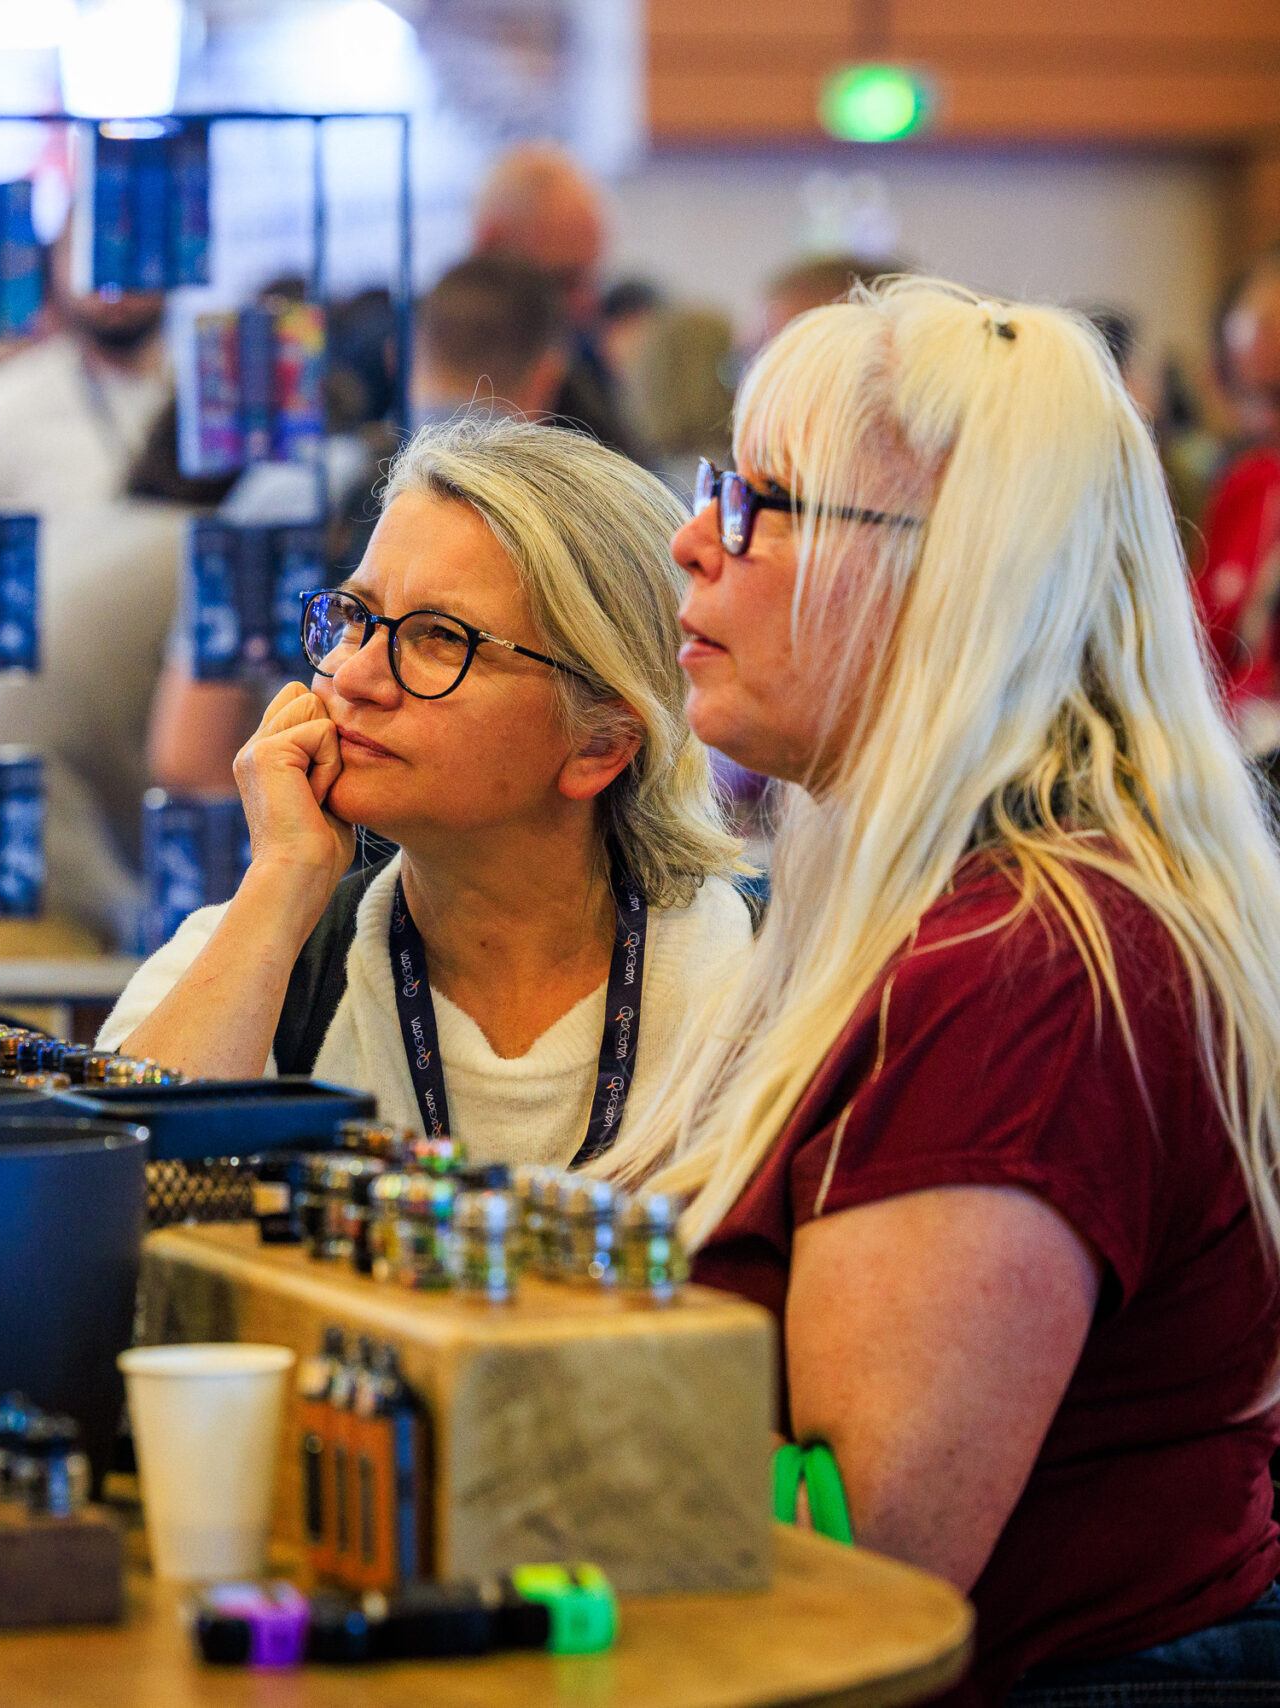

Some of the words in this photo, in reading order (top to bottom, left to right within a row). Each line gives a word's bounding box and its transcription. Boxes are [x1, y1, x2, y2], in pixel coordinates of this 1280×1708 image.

[400, 949, 419, 998] VAPEXPO
[623, 932, 640, 985] VAPEXPO
[410, 1016, 430, 1070] VAPEXPO
[616, 1005, 633, 1059] VAPEXPO
[603, 1076, 624, 1128] VAPEXPO
